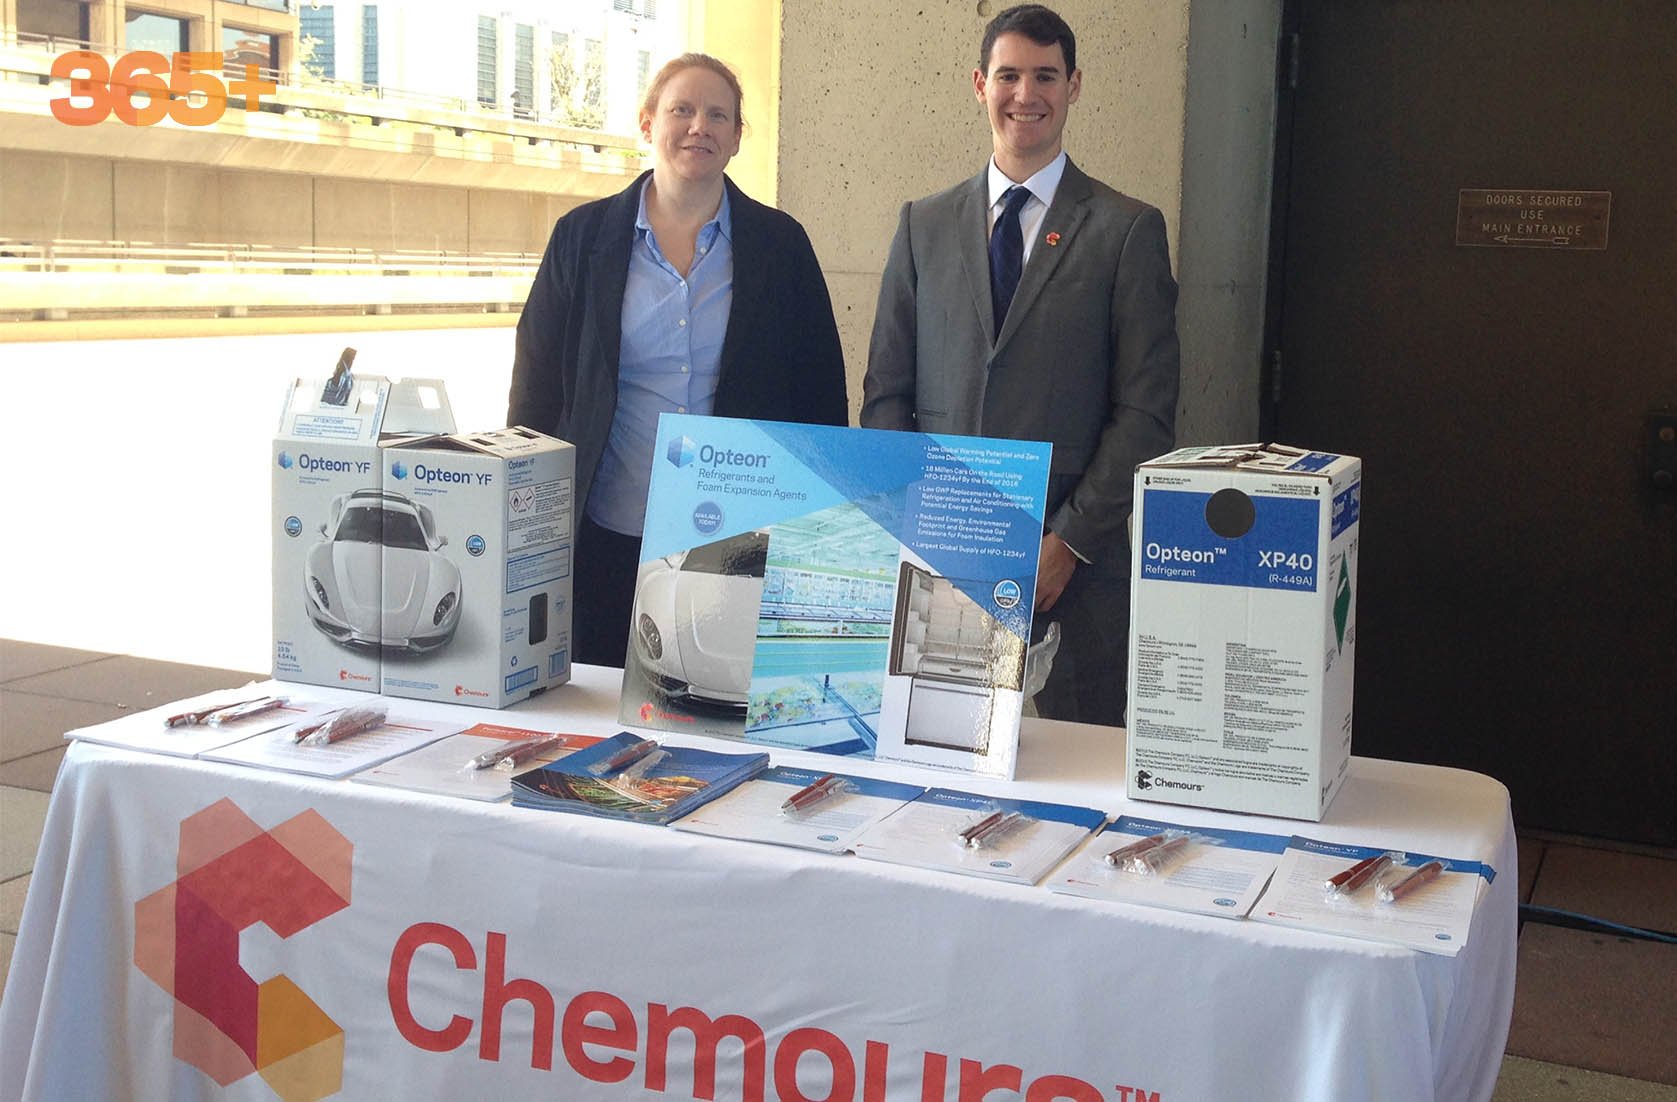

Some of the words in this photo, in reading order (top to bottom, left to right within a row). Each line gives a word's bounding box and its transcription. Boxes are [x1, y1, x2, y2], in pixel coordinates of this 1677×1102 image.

[1486, 194, 1522, 206] DOORS
[1529, 195, 1582, 208] SECURED
[1520, 209, 1544, 221] USE
[1481, 223, 1511, 234] MAIN
[1517, 224, 1582, 237] ENTRANCE
[940, 446, 960, 454] Global
[960, 447, 985, 456] Warming
[985, 449, 1013, 458] Potential
[1025, 452, 1039, 461] Zero
[945, 454, 974, 463] Depletion
[974, 457, 1002, 465] Potential
[355, 461, 371, 474] YF
[476, 473, 492, 486] YF
[698, 467, 756, 484] Refrigerants
[757, 474, 775, 485] and
[924, 473, 962, 483] HFO-1234yf
[962, 475, 970, 483] By
[982, 477, 993, 485] End
[994, 478, 1001, 486] of
[989, 470, 1005, 478] Road
[1005, 472, 1023, 480] Using
[696, 480, 723, 493] Foam
[724, 485, 772, 500] Expansion
[773, 488, 807, 502] Agents
[950, 487, 992, 498] Replacements
[1002, 493, 1034, 503] Stationary
[920, 502, 948, 510] Potential
[948, 504, 969, 512] Energy
[969, 505, 993, 514] Savings
[921, 494, 960, 504] Refrigeration
[960, 497, 973, 505] and
[982, 499, 1019, 509] Conditioning
[918, 521, 946, 531] Footprint
[946, 523, 958, 531] and
[958, 525, 993, 534] Greenhouse
[919, 513, 945, 521] Reduced
[968, 518, 1011, 528] Environmental
[917, 528, 947, 537] Emissions
[956, 532, 973, 540] Foam
[974, 534, 1004, 543] Insulation
[915, 541, 939, 551] Largest
[939, 543, 958, 552] Global
[958, 545, 979, 554] Supply
[987, 548, 1026, 559] HFO-1234yf
[1257, 550, 1313, 571] XP40
[1144, 563, 1196, 578] Refrigerant
[1268, 574, 1313, 587] (R-449A)
